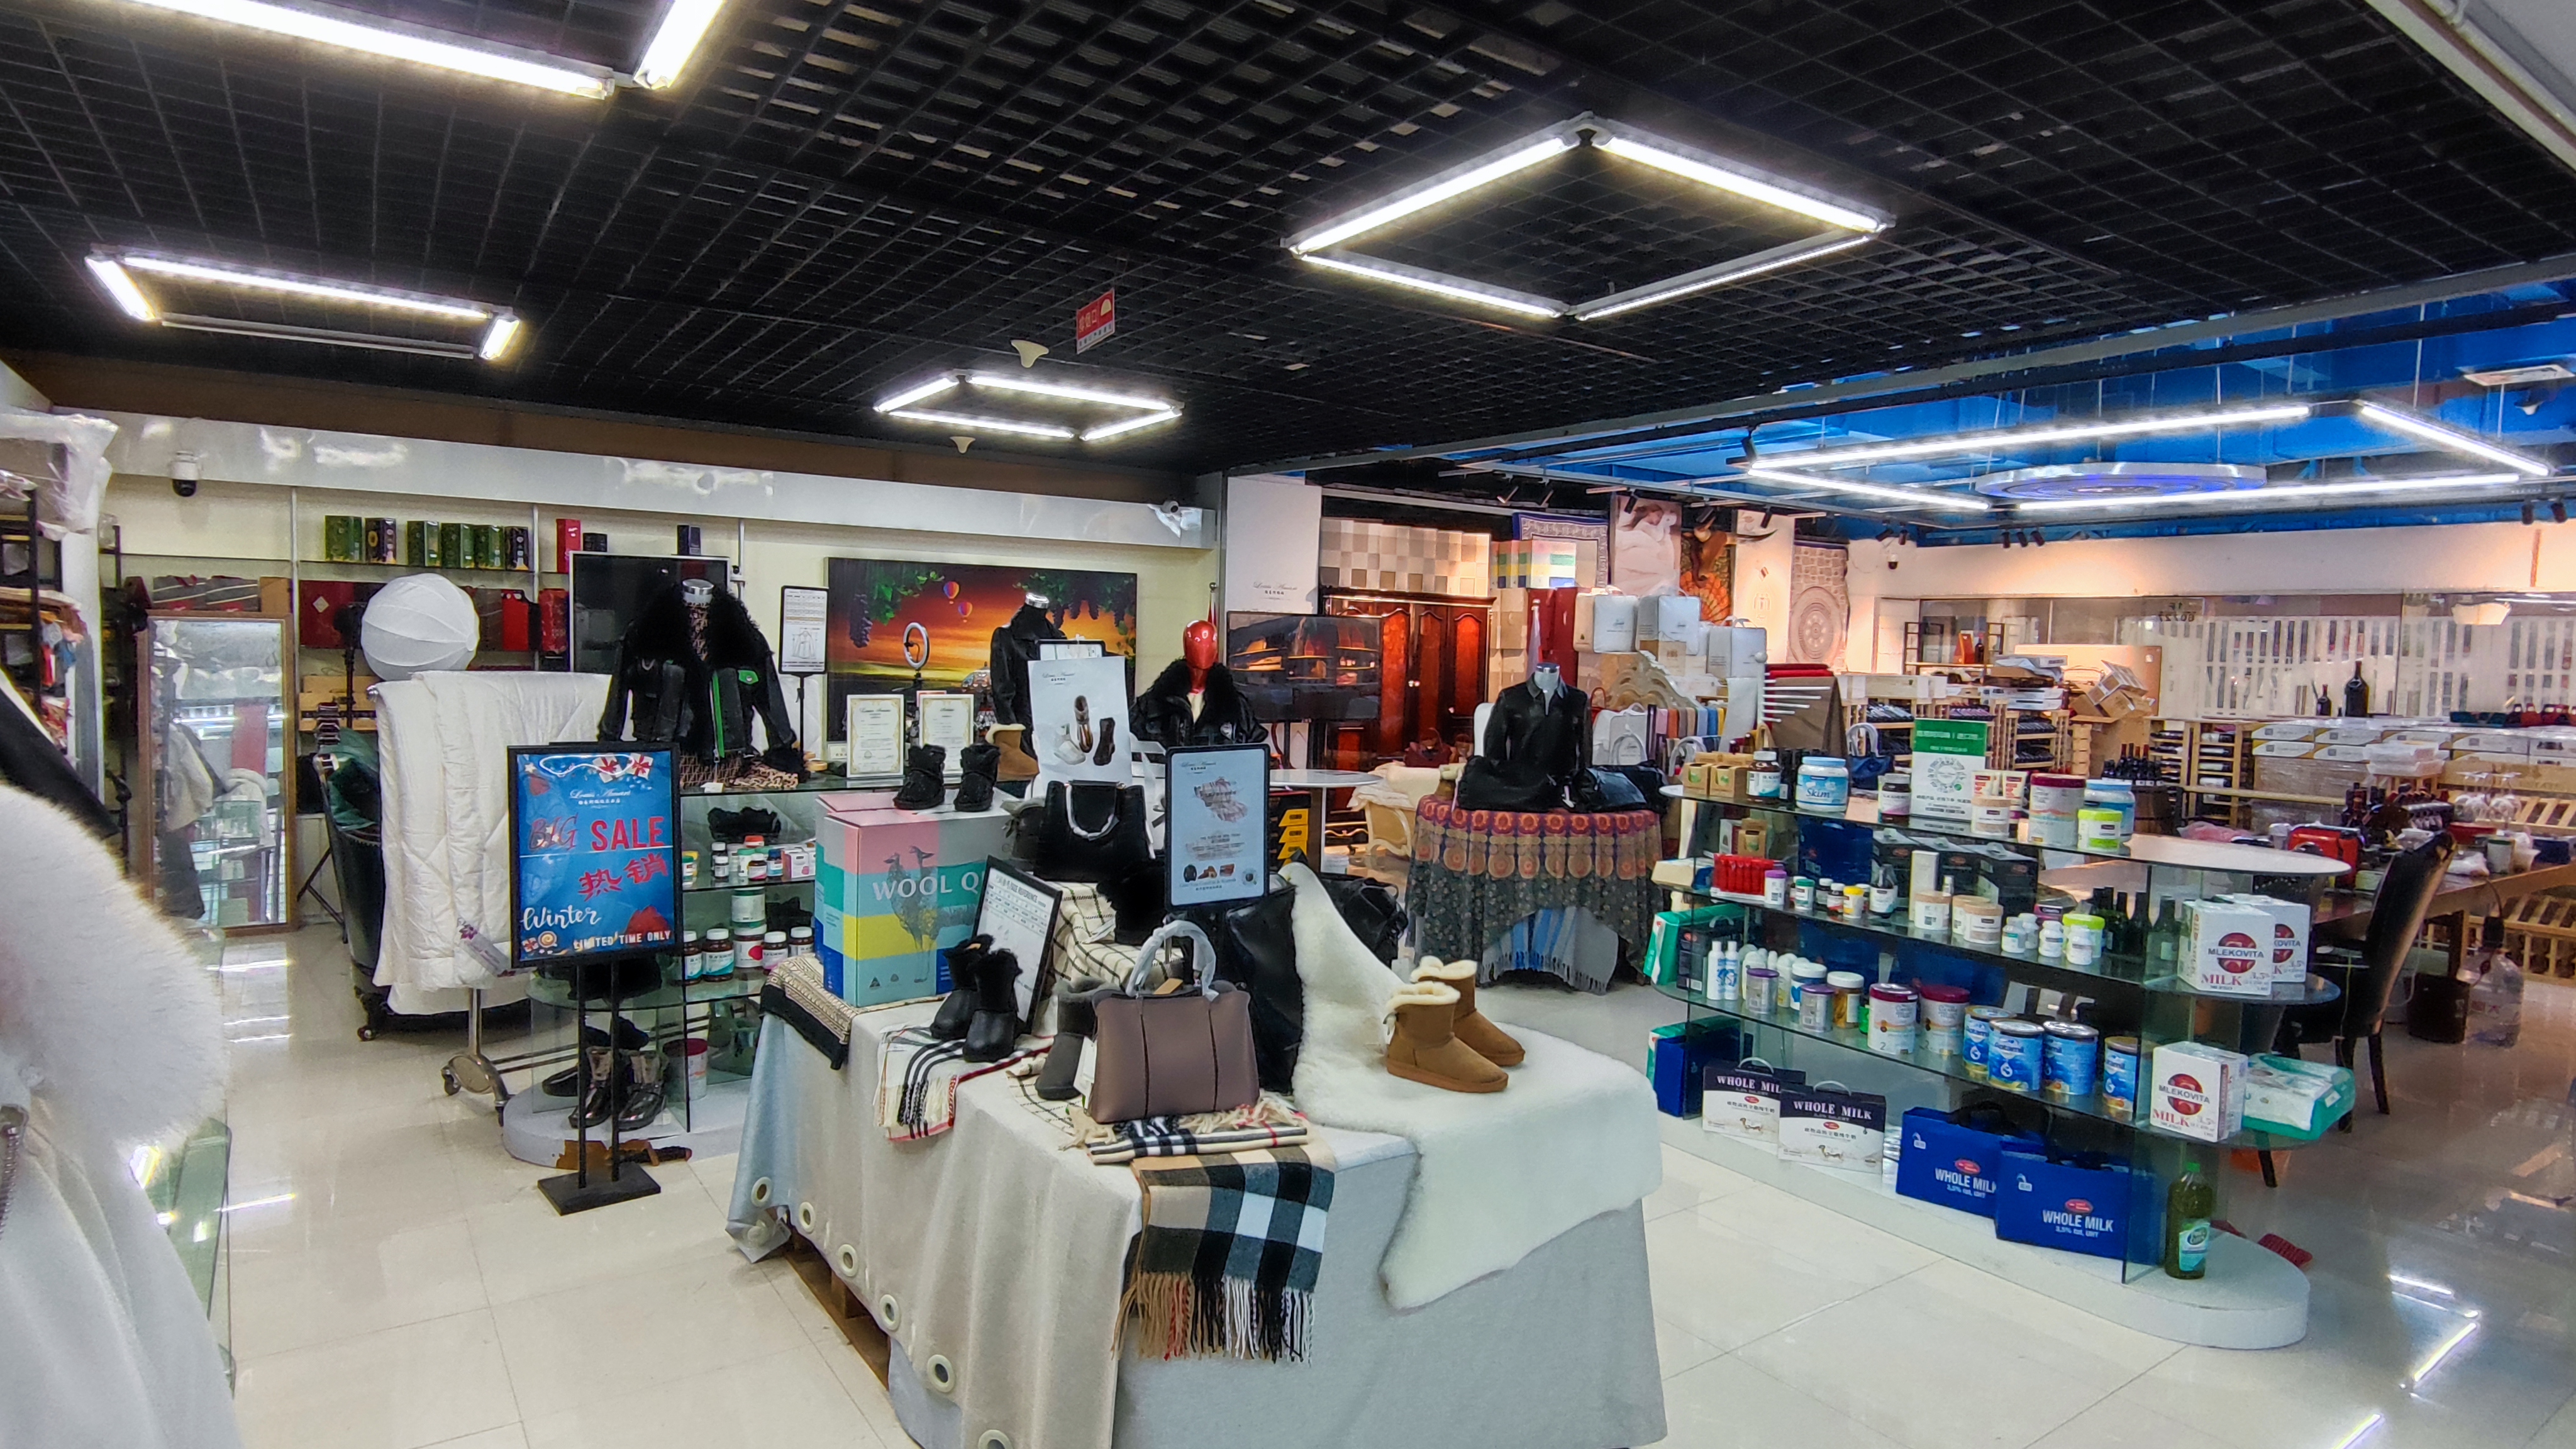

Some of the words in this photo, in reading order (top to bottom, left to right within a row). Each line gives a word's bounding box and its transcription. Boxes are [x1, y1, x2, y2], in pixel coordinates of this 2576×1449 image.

[1806, 788, 1829, 798] Skim
[530, 813, 579, 850] BIG
[591, 816, 664, 851] SALE
[578, 853, 669, 902] 热销
[872, 875, 952, 900] WOOL
[519, 904, 601, 931] Winter
[573, 936, 614, 952] LIMITED
[619, 933, 642, 944] TIME
[647, 930, 671, 941] ONLY
[2208, 948, 2264, 958] MLEKOVITA
[2201, 974, 2242, 985] MILK
[1717, 1075, 1755, 1089] WHOLE
[1761, 1080, 1782, 1094] MIL
[2158, 1084, 2211, 1104] MLEKOVITA
[1793, 1101, 1835, 1114] WHOLE
[1841, 1106, 1872, 1119] MILK
[2153, 1109, 2190, 1128] MILK
[1935, 1168, 1970, 1187] WHOLE
[2042, 1209, 2082, 1227] WHOLE
[2085, 1216, 2114, 1232] MILK
